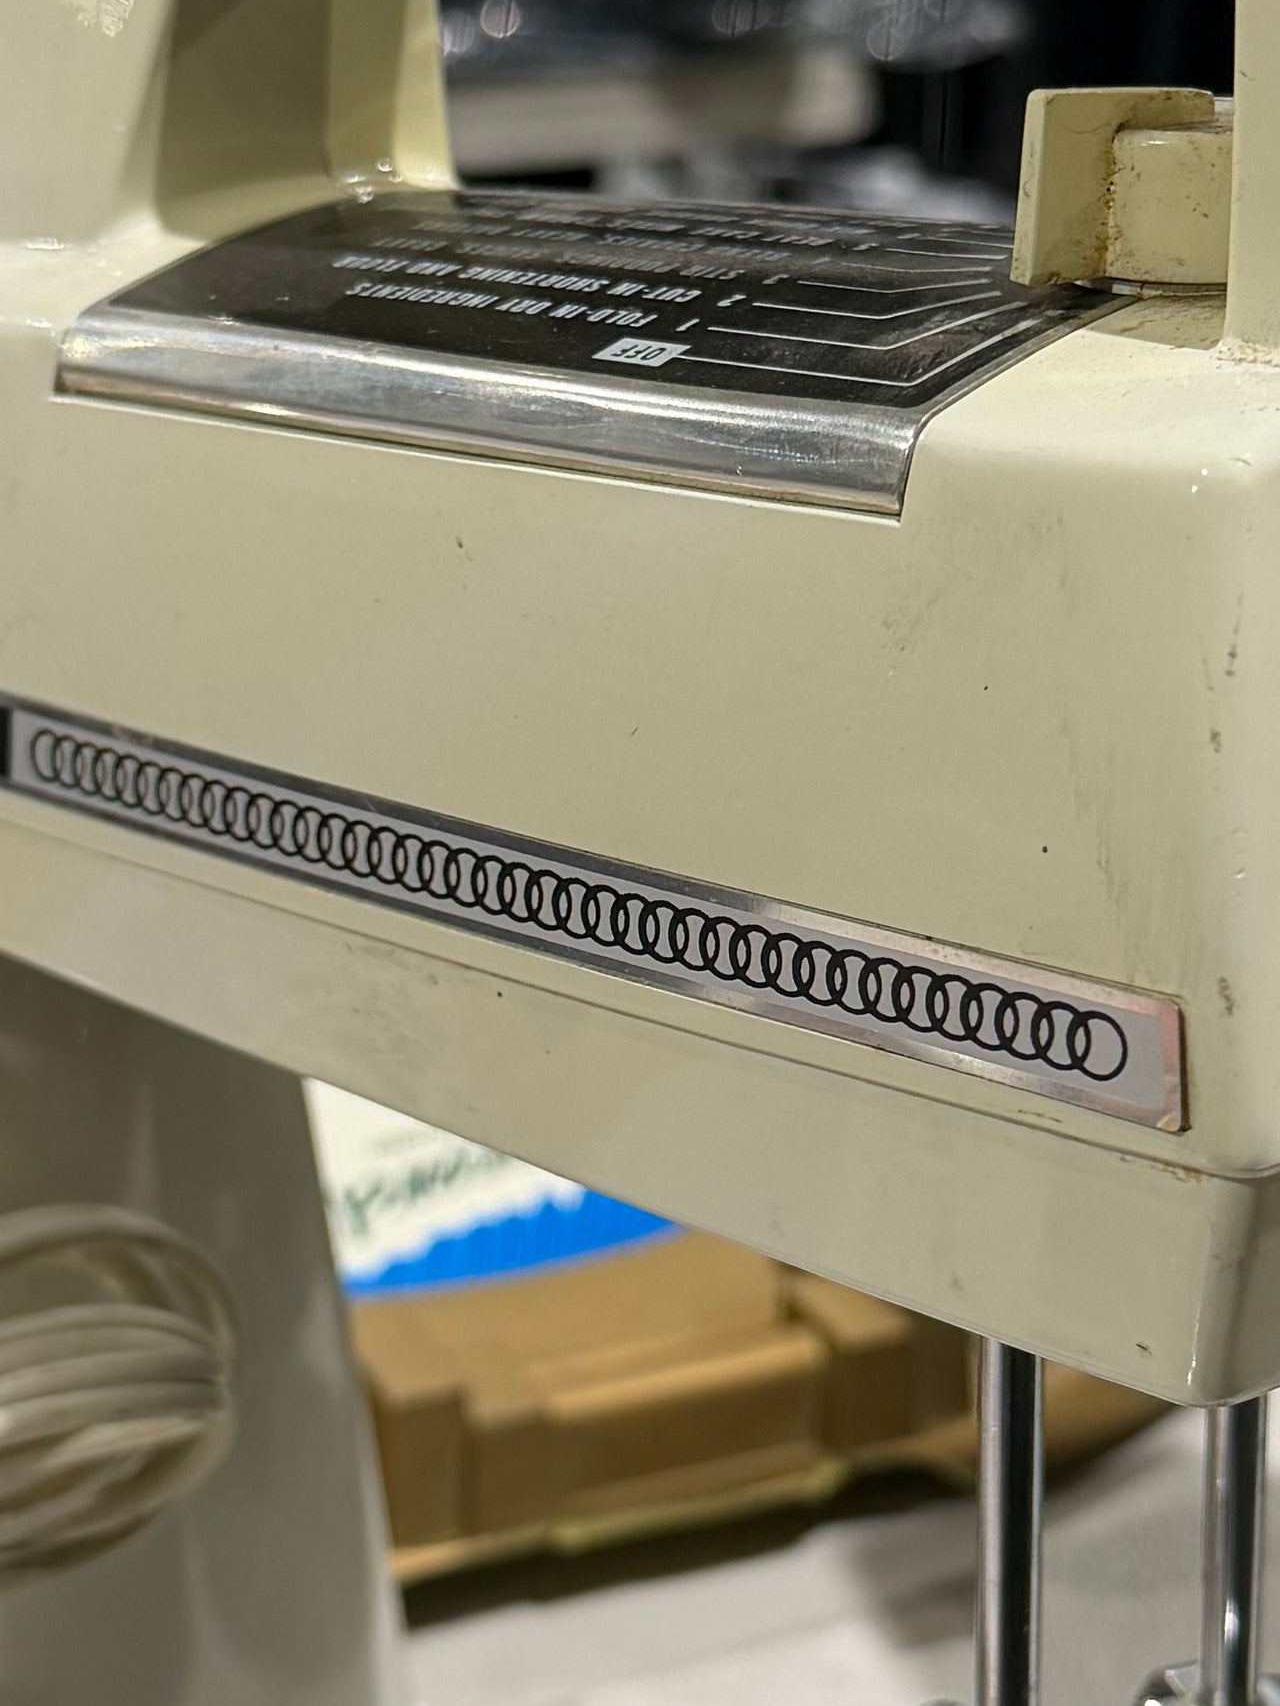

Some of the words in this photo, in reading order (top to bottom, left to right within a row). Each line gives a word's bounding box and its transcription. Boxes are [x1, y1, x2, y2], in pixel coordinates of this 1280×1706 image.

[405, 262, 462, 277] AND
[458, 266, 609, 292] SHORTENING
[345, 282, 499, 308] INGREDIENTS
[605, 282, 702, 303] CUT-IN
[716, 294, 746, 307] 2
[494, 298, 551, 315] DRY
[548, 304, 658, 327] FOLD-IN
[676, 318, 700, 332] 1
[611, 345, 666, 361] OFF
